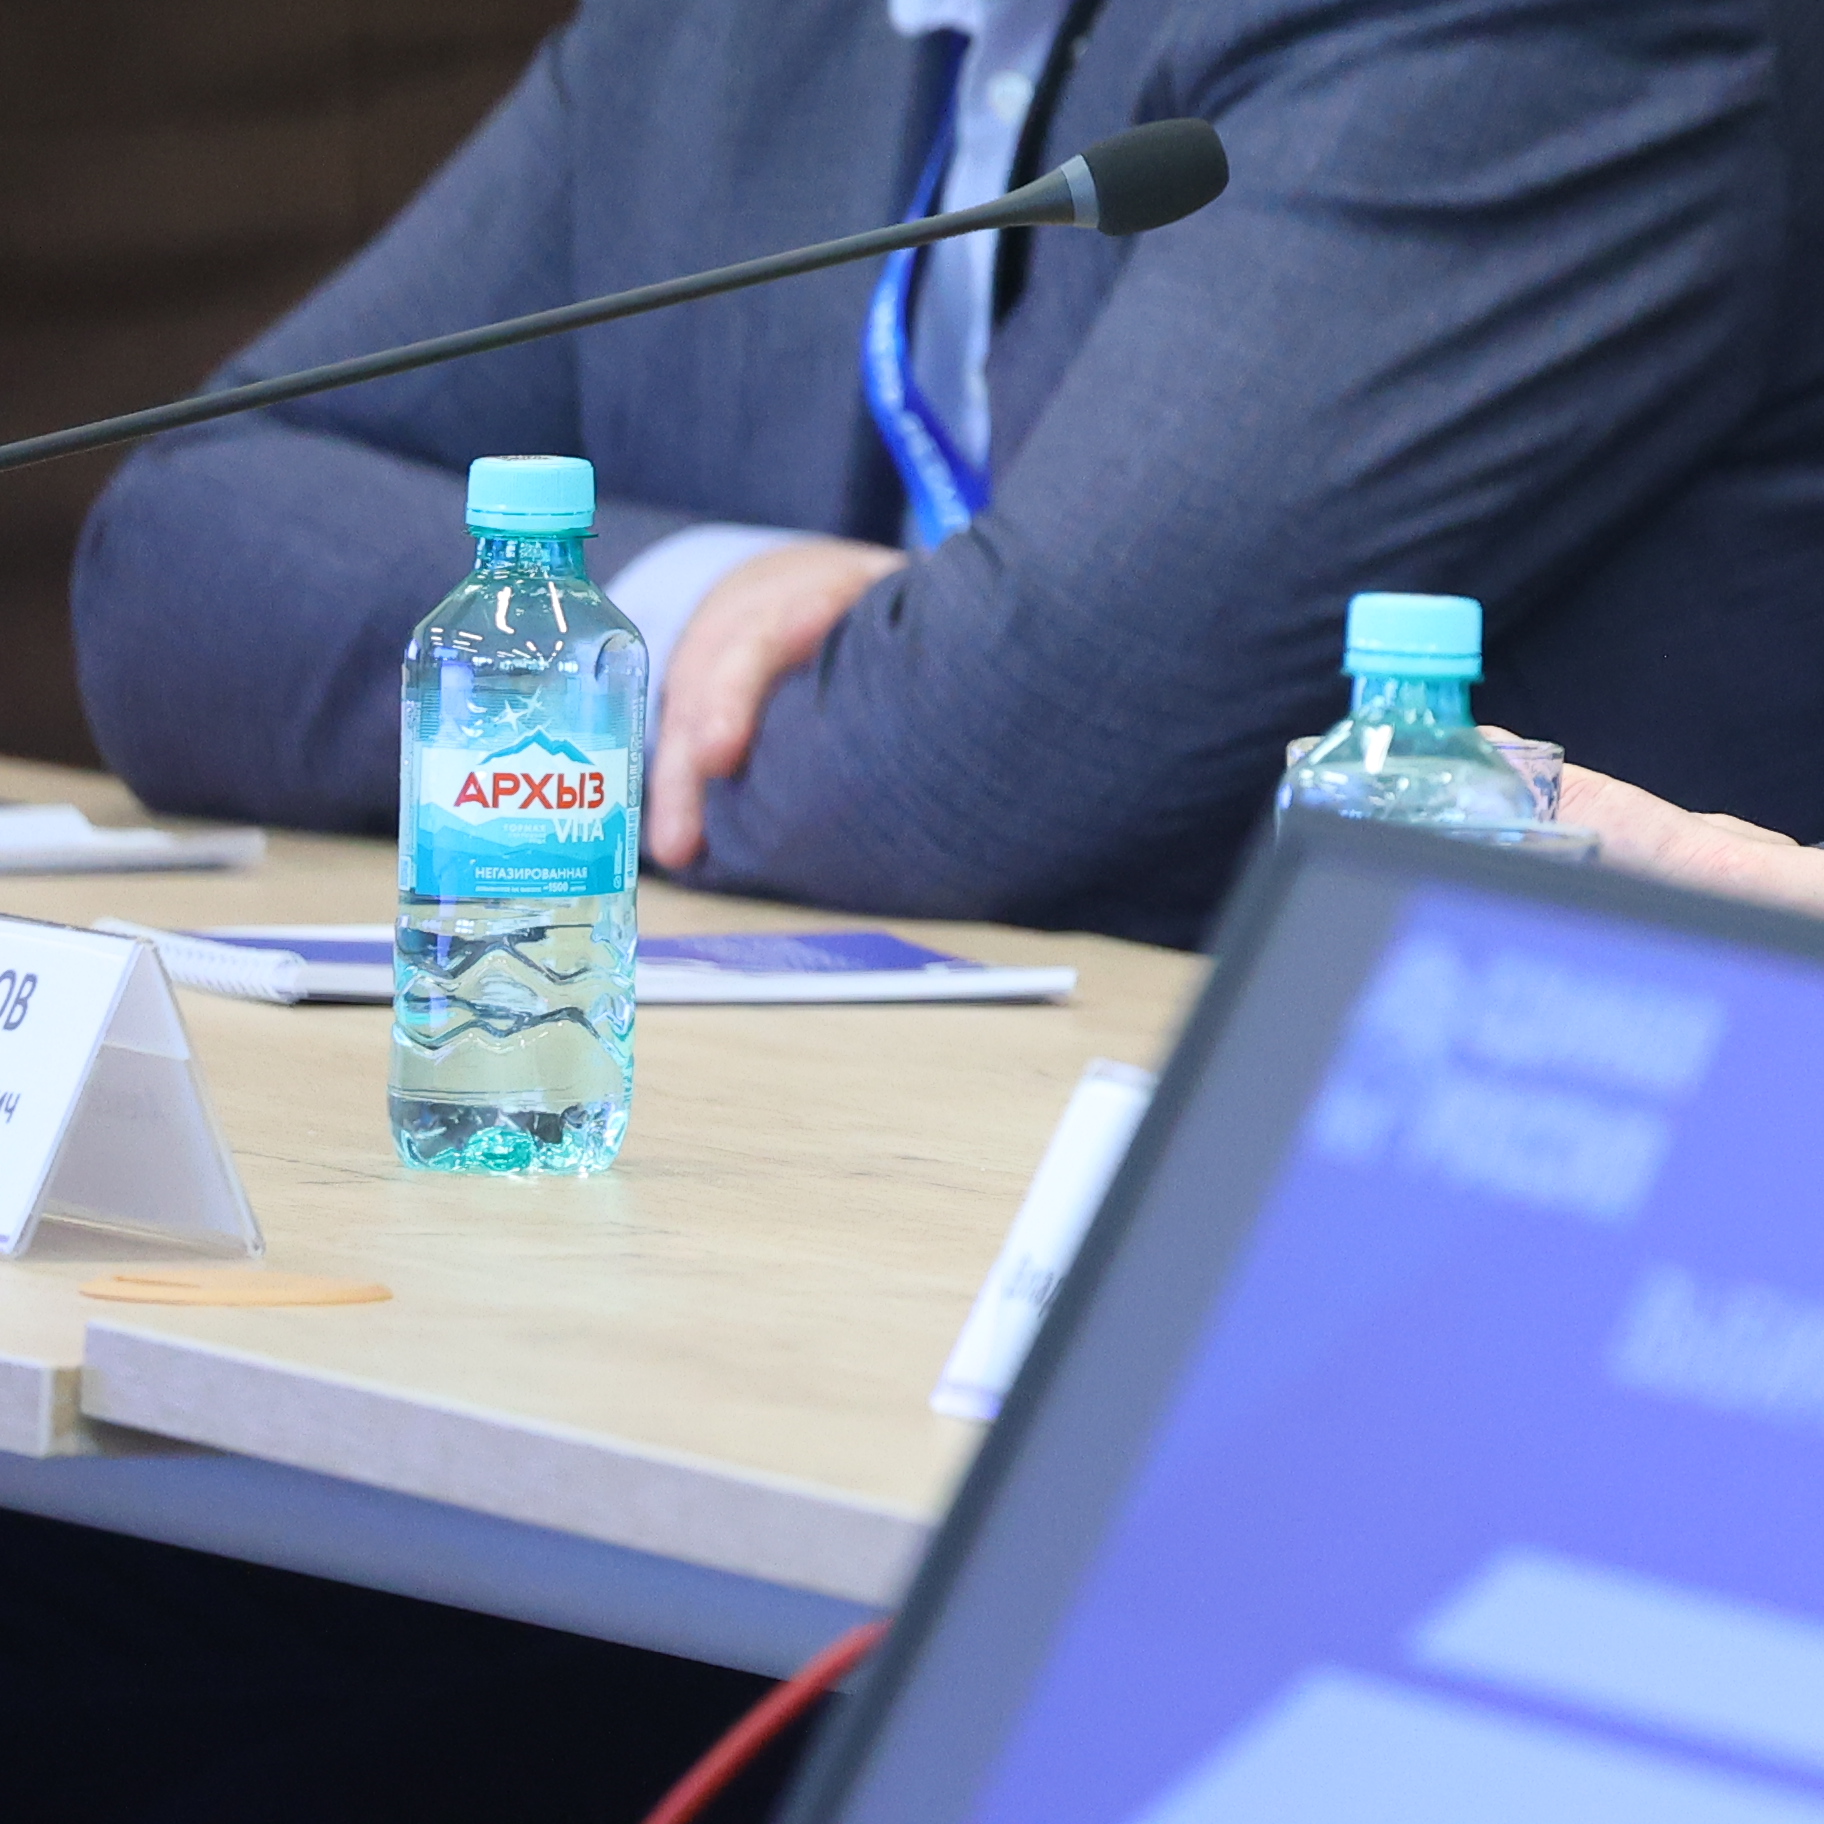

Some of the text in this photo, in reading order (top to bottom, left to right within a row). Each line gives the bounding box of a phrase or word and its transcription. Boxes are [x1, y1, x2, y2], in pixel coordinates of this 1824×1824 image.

[453, 771, 605, 810] АРХЫЗ
[553, 817, 605, 844] VITA
[474, 866, 588, 880] НЕГАЗИРОВАННАЯ
